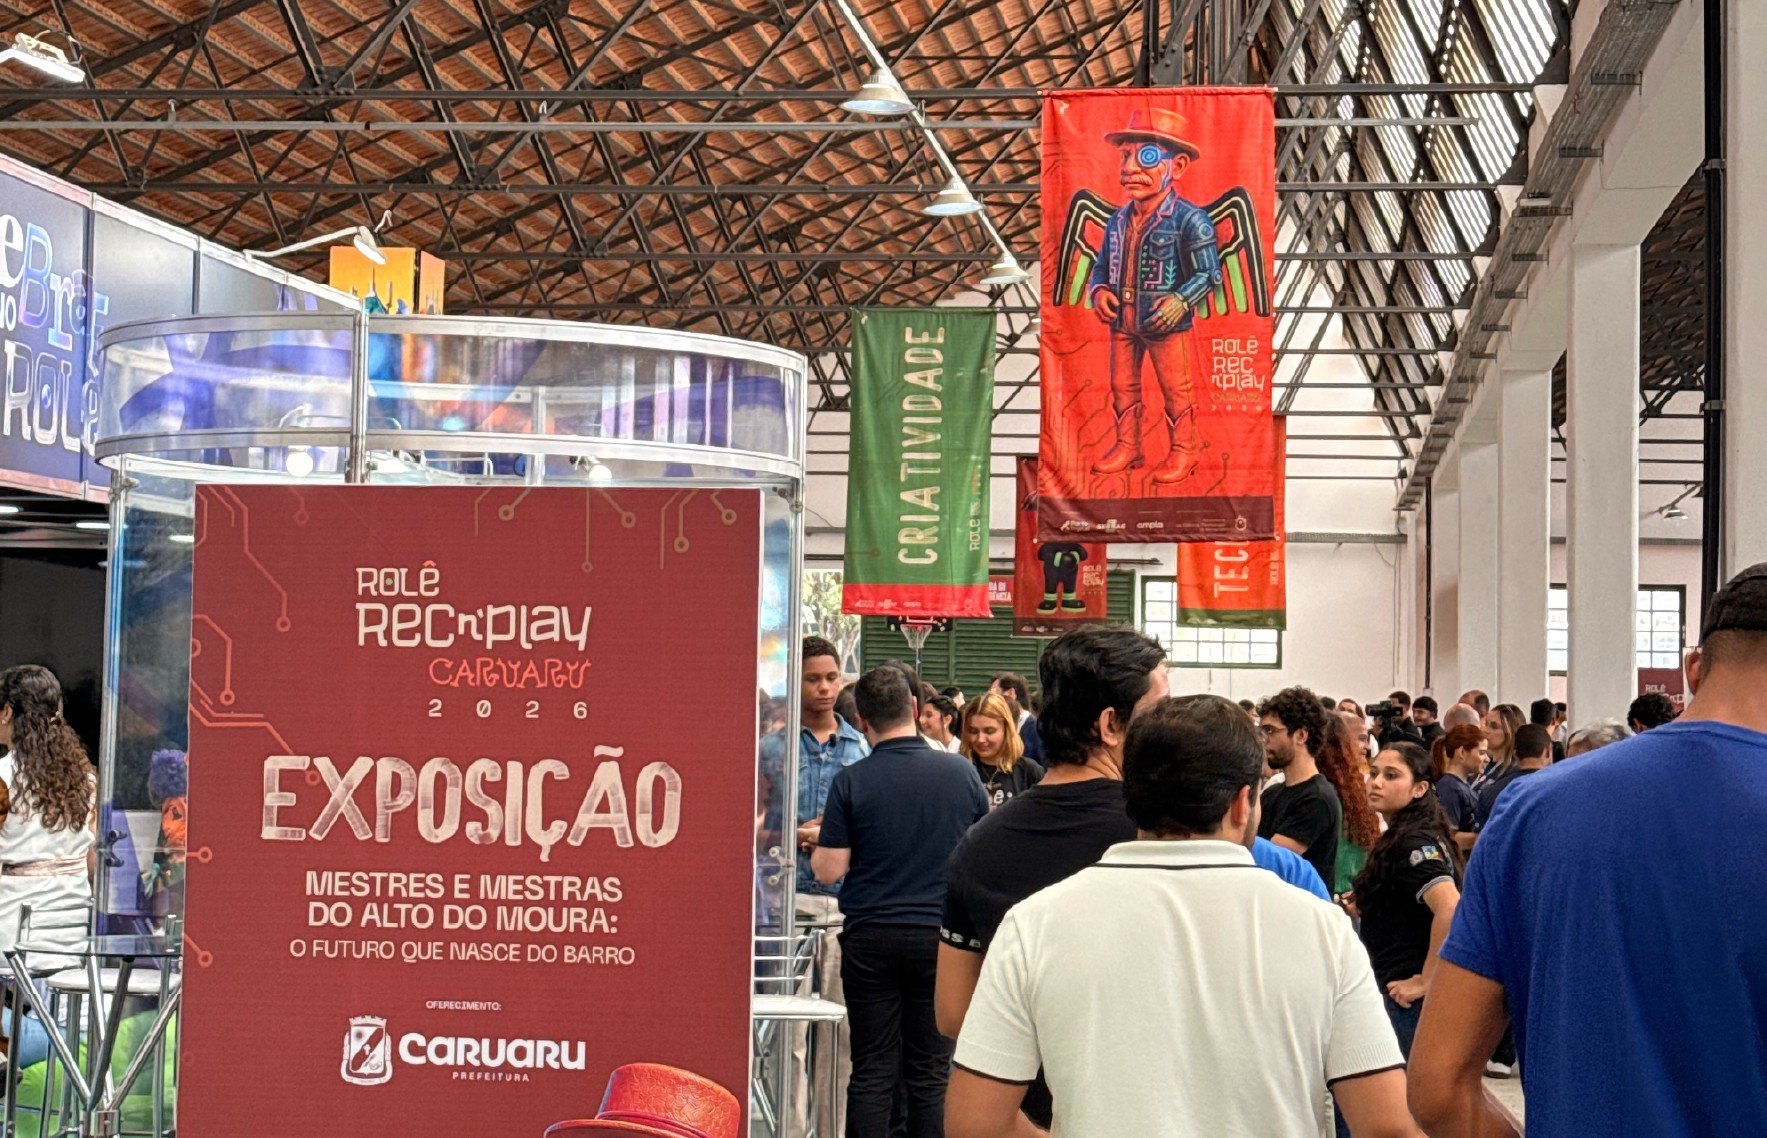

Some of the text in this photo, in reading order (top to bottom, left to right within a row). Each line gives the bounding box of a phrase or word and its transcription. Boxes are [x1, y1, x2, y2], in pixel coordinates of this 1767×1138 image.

[898, 326, 945, 564] CRIATIVIDADE
[428, 657, 592, 689] CARUARU
[261, 745, 682, 862] EXPOSIÇÃO
[305, 870, 623, 902] MESTRES E MESTRAS
[308, 901, 619, 934] DO ALTO DO MOURA:
[289, 938, 636, 965] O FUTURO QUE NASCE DO BARRO
[425, 1000, 502, 1012] OFERECIMENTO:
[452, 1071, 530, 1082] PREFEITURA
